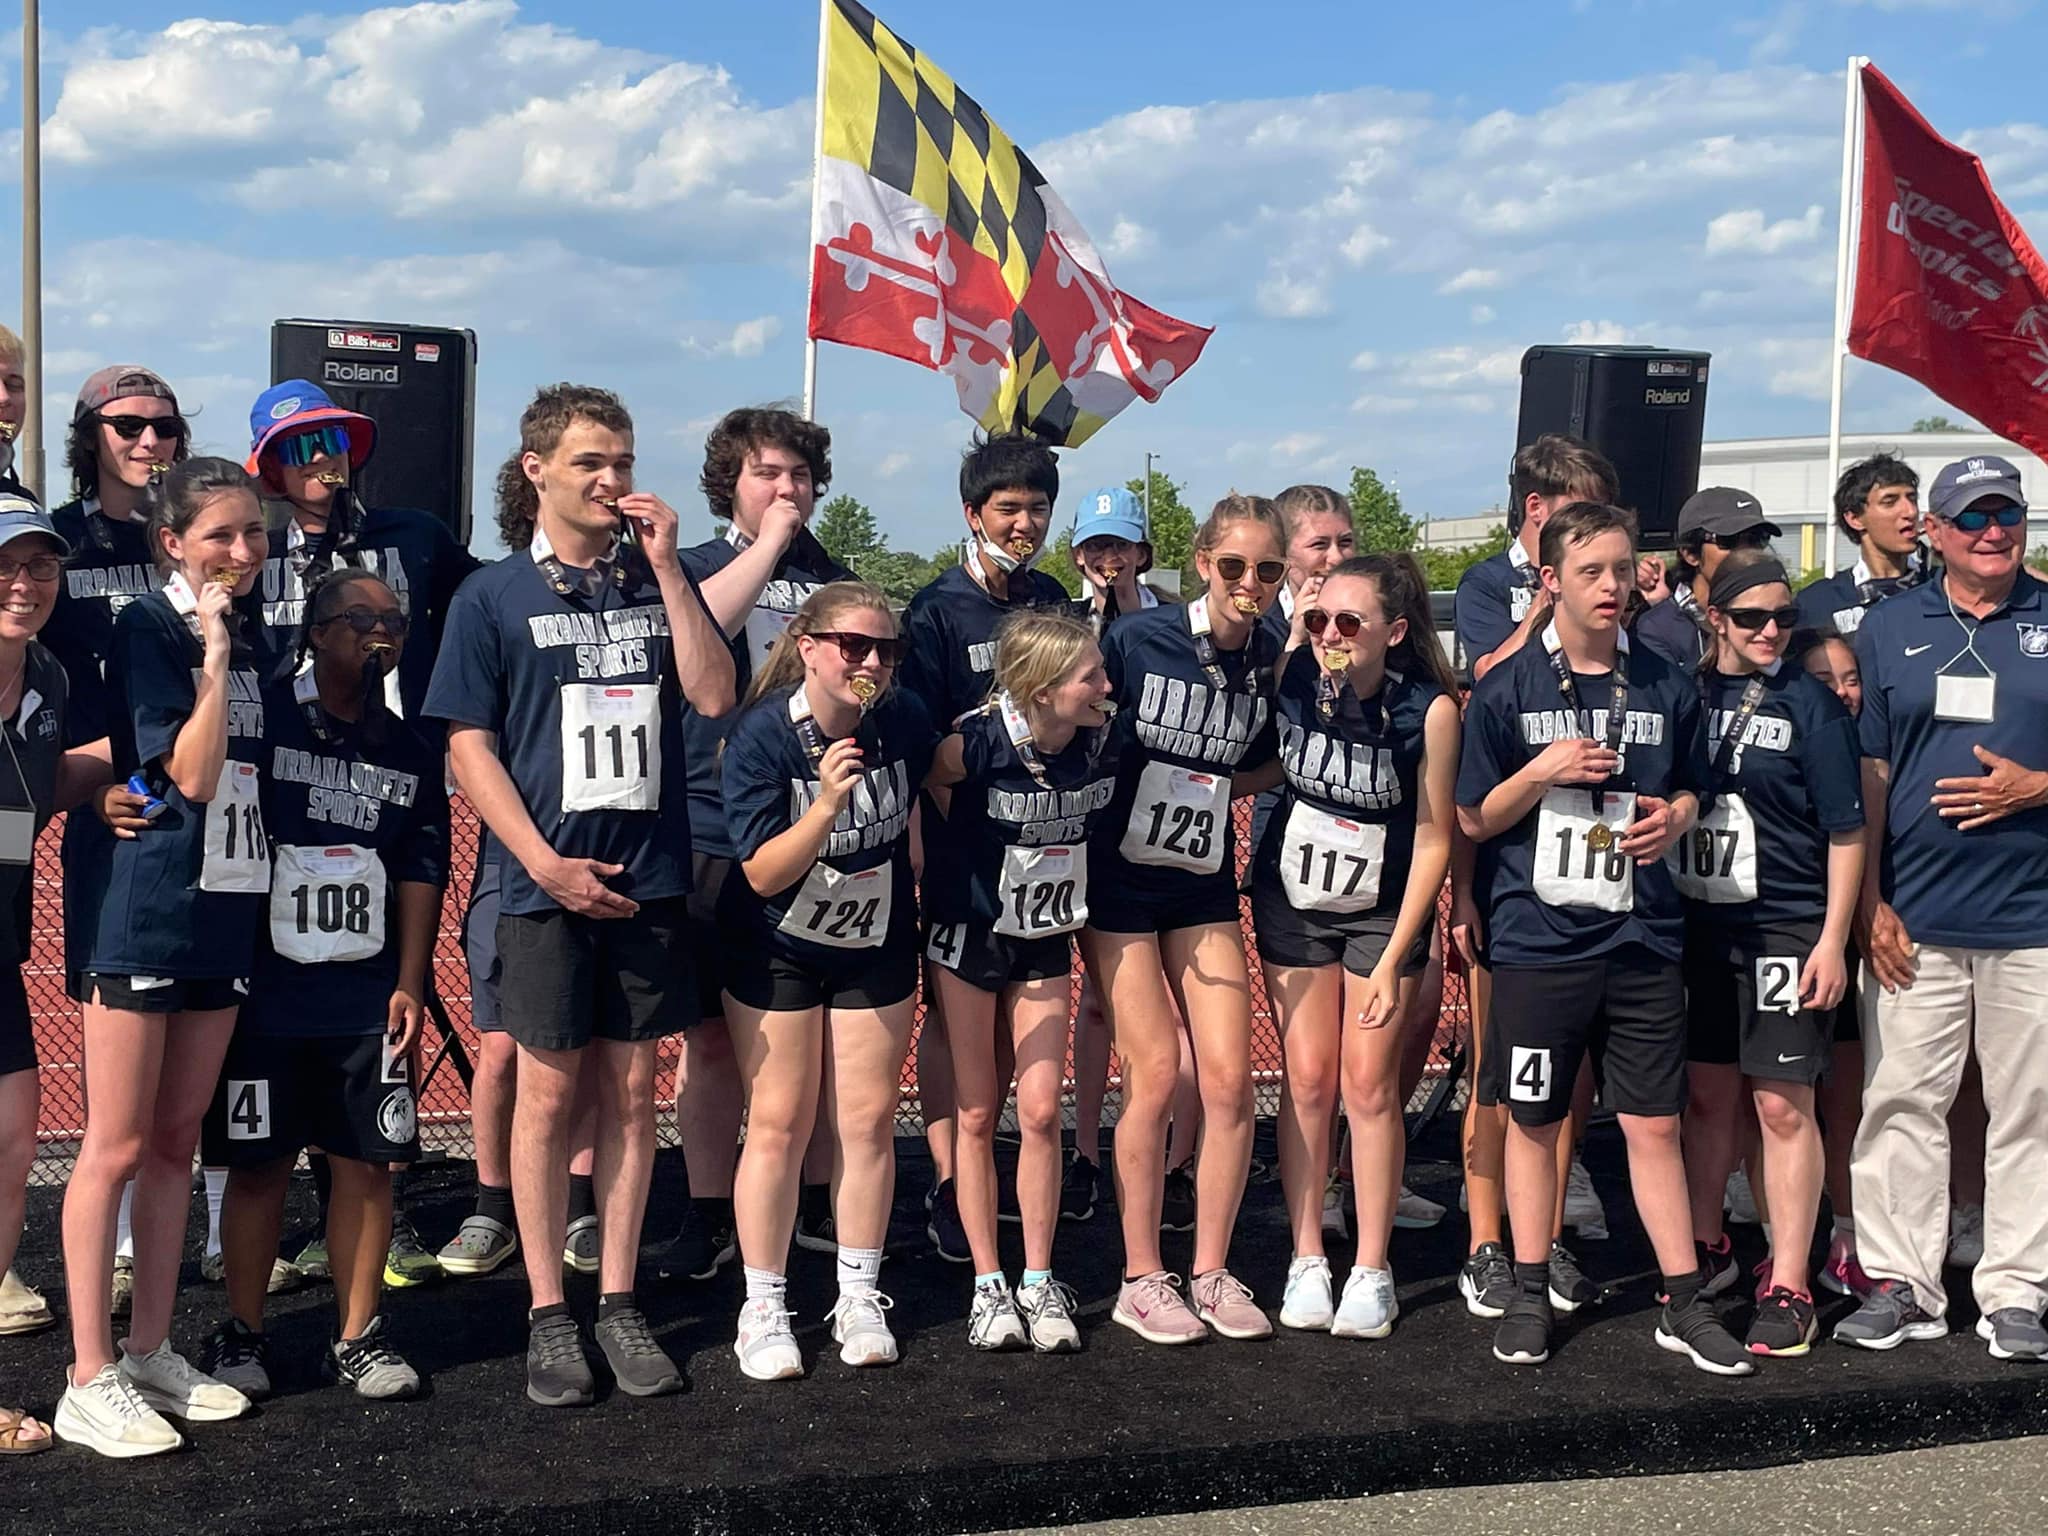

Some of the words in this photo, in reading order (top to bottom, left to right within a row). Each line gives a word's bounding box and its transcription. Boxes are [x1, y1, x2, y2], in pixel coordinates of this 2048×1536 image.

[324, 361, 398, 382] Roland
[1645, 388, 1690, 404] Roland
[528, 612, 608, 649] URBANA
[603, 603, 672, 642] UNIFIE
[575, 638, 648, 679] SPORTS
[272, 745, 350, 792] URBANA
[578, 724, 648, 779] 111
[1276, 711, 1400, 794] URBANA
[306, 786, 382, 832] SPORTS
[987, 786, 1060, 823] URBANA
[1330, 784, 1403, 810] SPORTS
[1016, 813, 1086, 845] SPORTS
[1145, 800, 1215, 860] 123
[1298, 842, 1369, 896] 117
[291, 883, 370, 934] 108
[806, 897, 881, 939] 124
[1011, 879, 1076, 931] 120
[932, 923, 957, 962] 4
[1762, 961, 1791, 1007] 2
[1515, 1052, 1545, 1097] 4
[231, 1083, 263, 1134] 4
